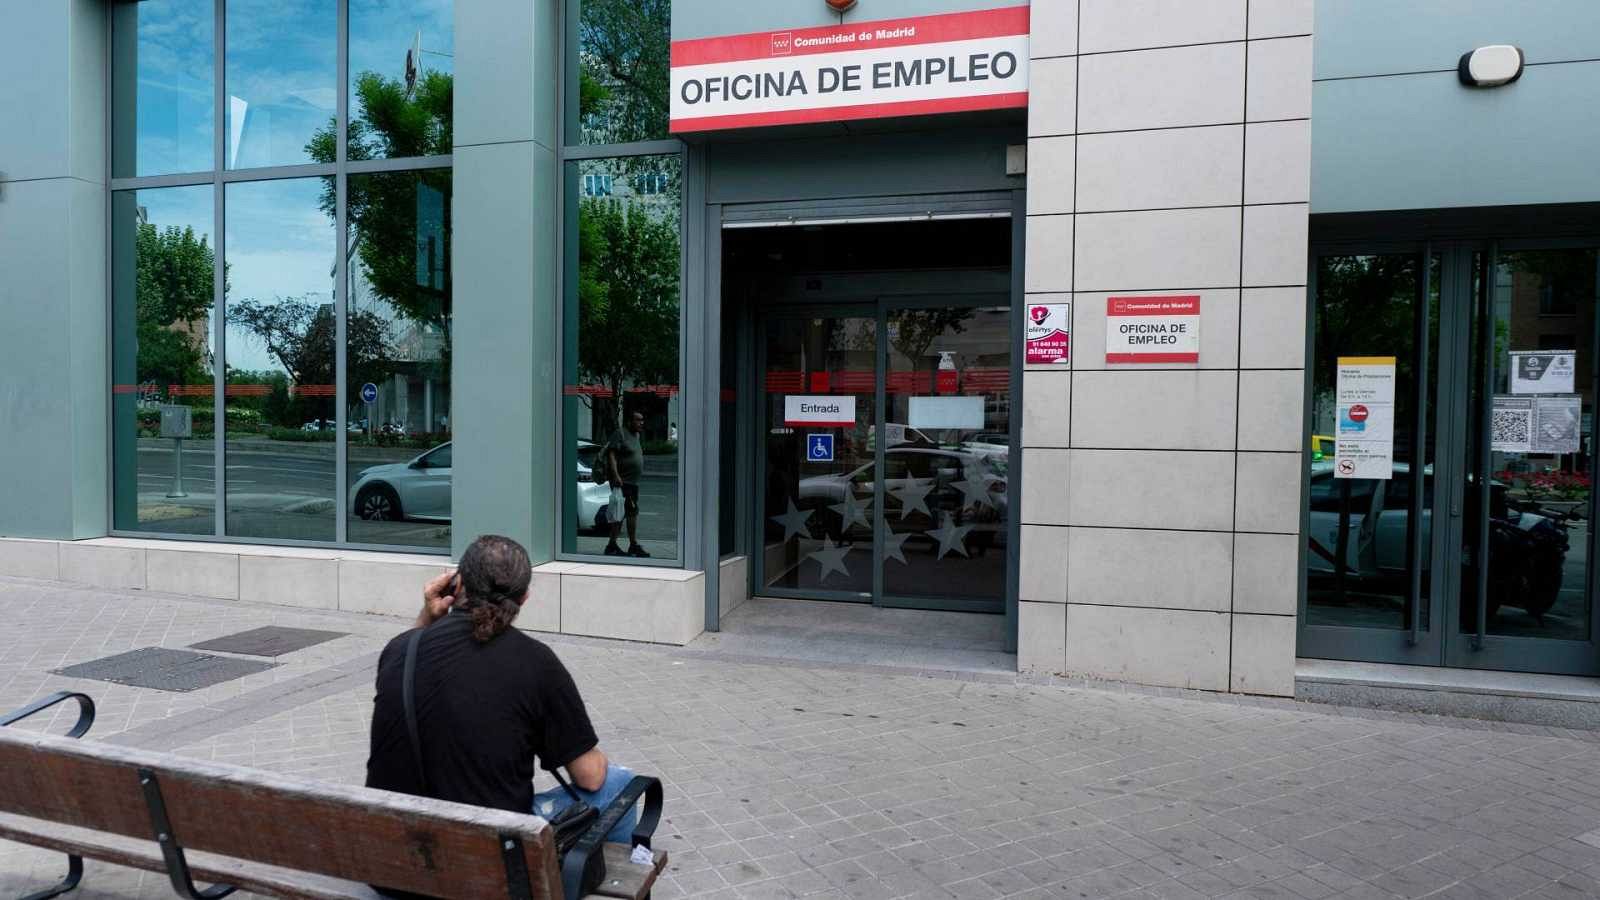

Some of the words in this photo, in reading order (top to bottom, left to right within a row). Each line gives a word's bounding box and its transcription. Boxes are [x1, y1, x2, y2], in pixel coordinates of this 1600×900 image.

[794, 33, 856, 48] Comunidad
[858, 31, 872, 42] de
[876, 27, 915, 40] Madrid
[681, 70, 808, 105] OFICINA
[818, 65, 861, 94] DE
[872, 51, 1017, 90] EMPLEO
[1119, 324, 1167, 334] OFICINA
[1170, 323, 1186, 333] DE
[1128, 335, 1177, 344] EMPLEO
[800, 403, 840, 413] Entrada
